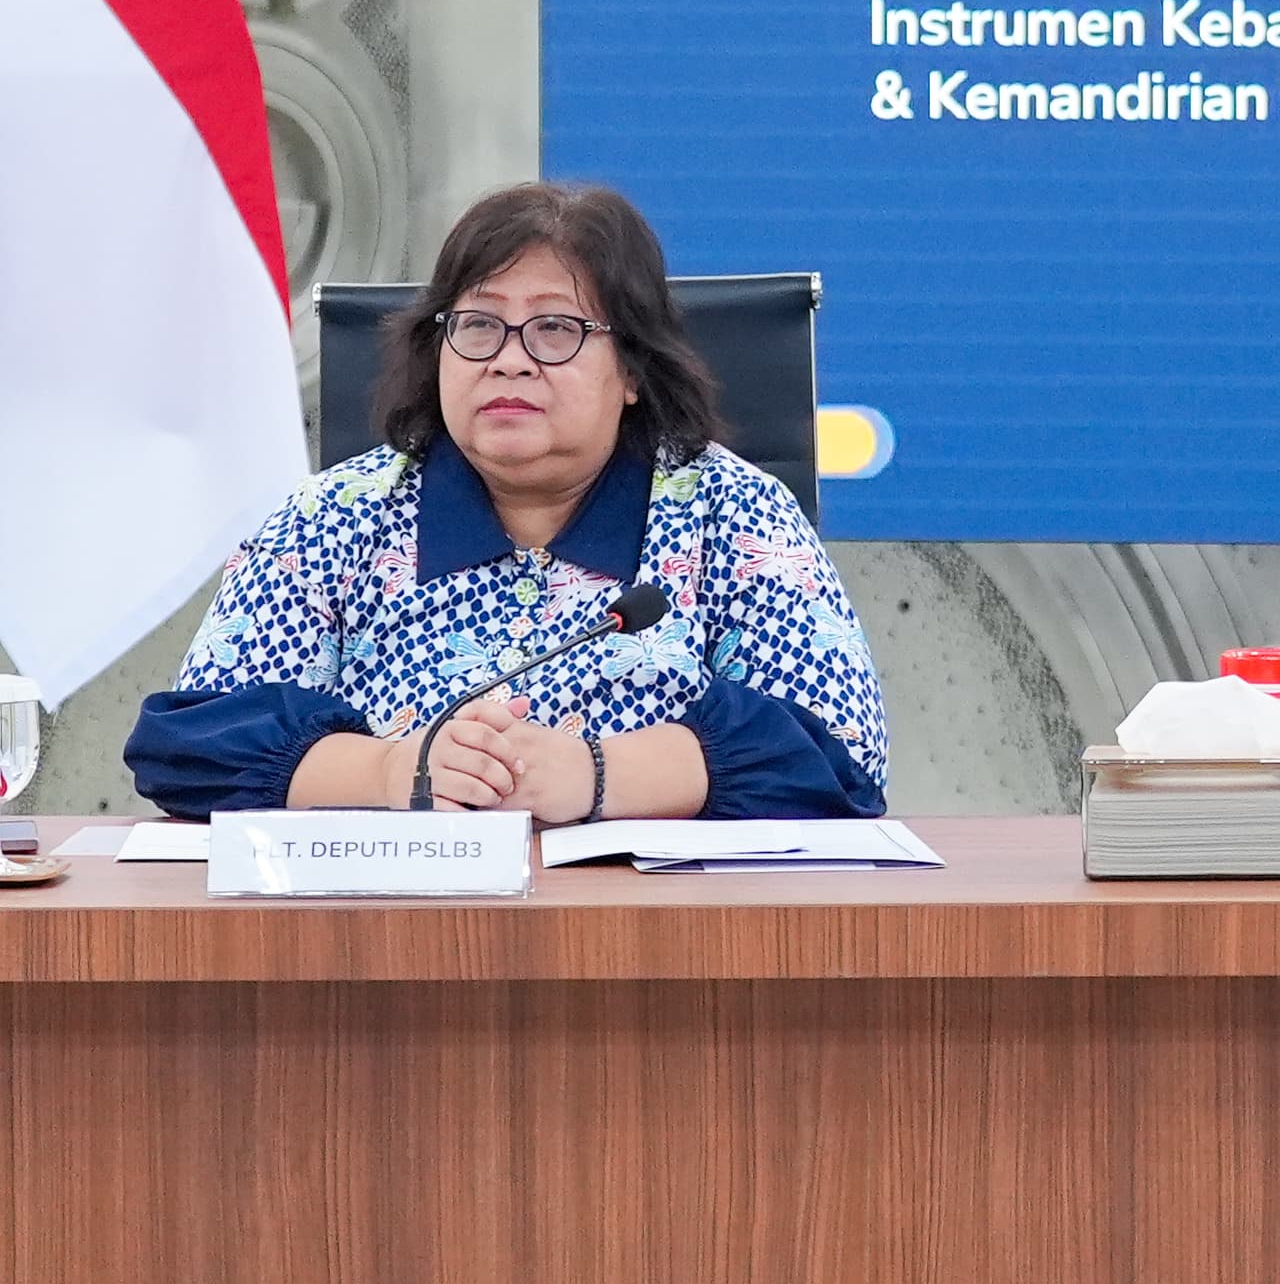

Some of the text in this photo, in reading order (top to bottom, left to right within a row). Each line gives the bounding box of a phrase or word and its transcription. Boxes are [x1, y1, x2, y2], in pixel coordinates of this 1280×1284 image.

[871, 71, 913, 120] &
[930, 71, 1268, 120] Kemandirian
[311, 841, 398, 858] DEPUTI
[408, 841, 482, 858] PSLB3
